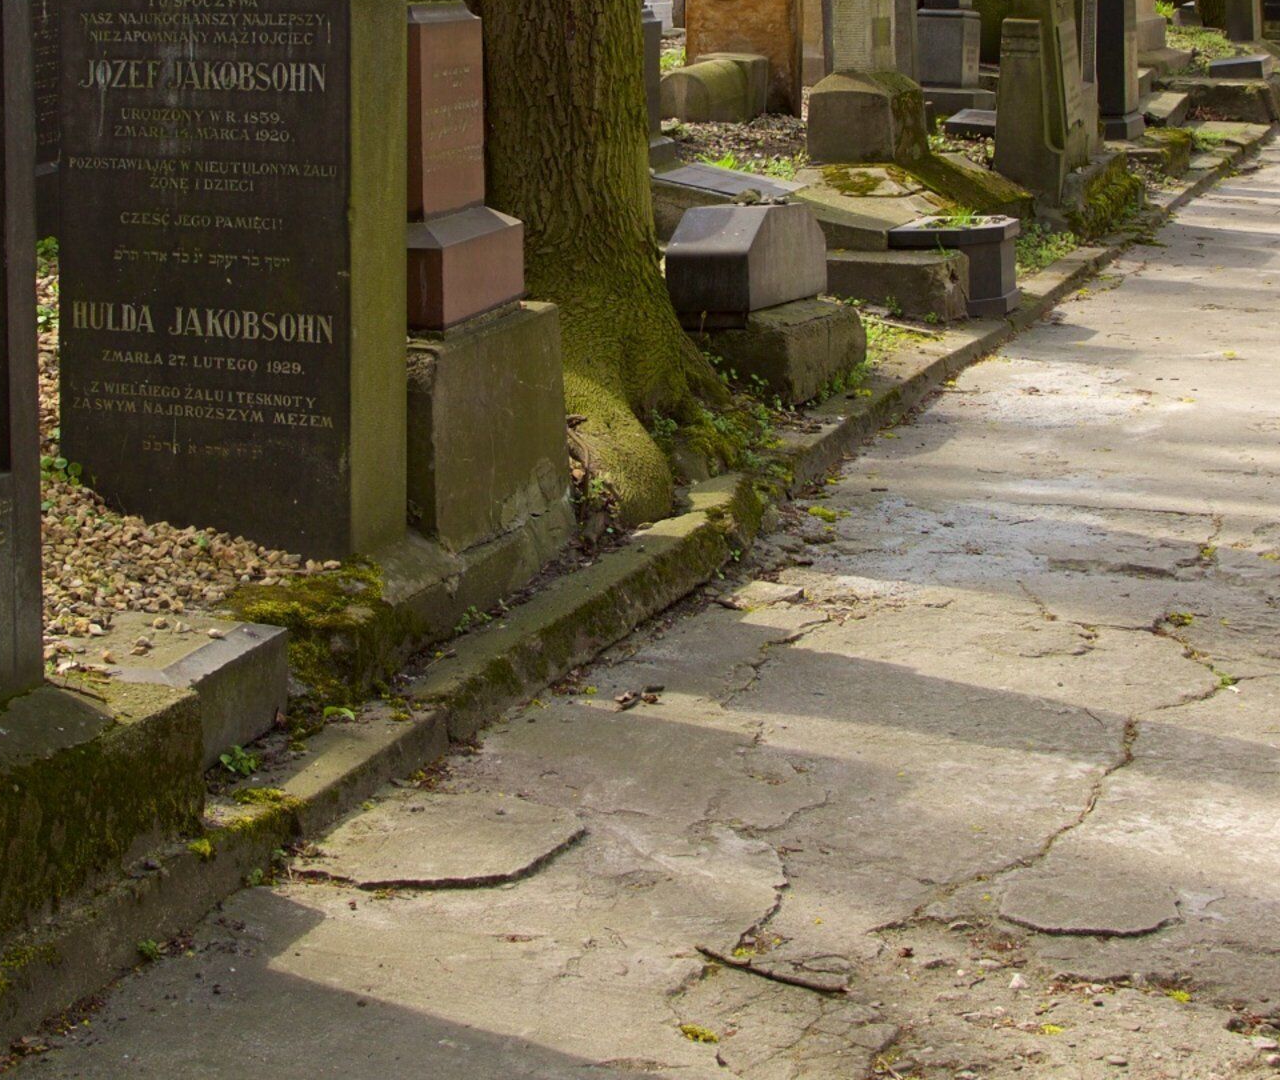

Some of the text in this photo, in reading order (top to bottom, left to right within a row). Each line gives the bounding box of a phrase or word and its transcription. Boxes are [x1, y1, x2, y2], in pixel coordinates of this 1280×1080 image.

[81, 13, 113, 26] NASZ
[242, 13, 325, 27] NAJLEPSZY
[89, 30, 208, 45] NIEZAPOMNIANY
[259, 32, 314, 46] OJCIEC
[78, 51, 327, 93] JÓZEF JAKOBSOHN
[121, 108, 203, 122] URODZONY
[209, 110, 222, 122] W
[196, 127, 251, 141] MARCA
[69, 158, 337, 177] POZOSTAWIAJĄC W NIEUTULONYM ŻALU
[204, 178, 255, 192] DZIECI
[120, 208, 170, 226] CZEŚĆ
[174, 215, 211, 228] JEGO
[72, 301, 333, 344] HULDA JAKOBSOHN
[101, 350, 163, 365] ZMARŁA
[193, 356, 258, 372] LUTEGO
[104, 382, 180, 399] WIELKIEGO
[185, 384, 223, 402] ŻALU
[237, 392, 317, 409] TĘSKNOTY
[73, 397, 333, 430] ZA SWYM NAJDROŻSZYM MĘŻEM
